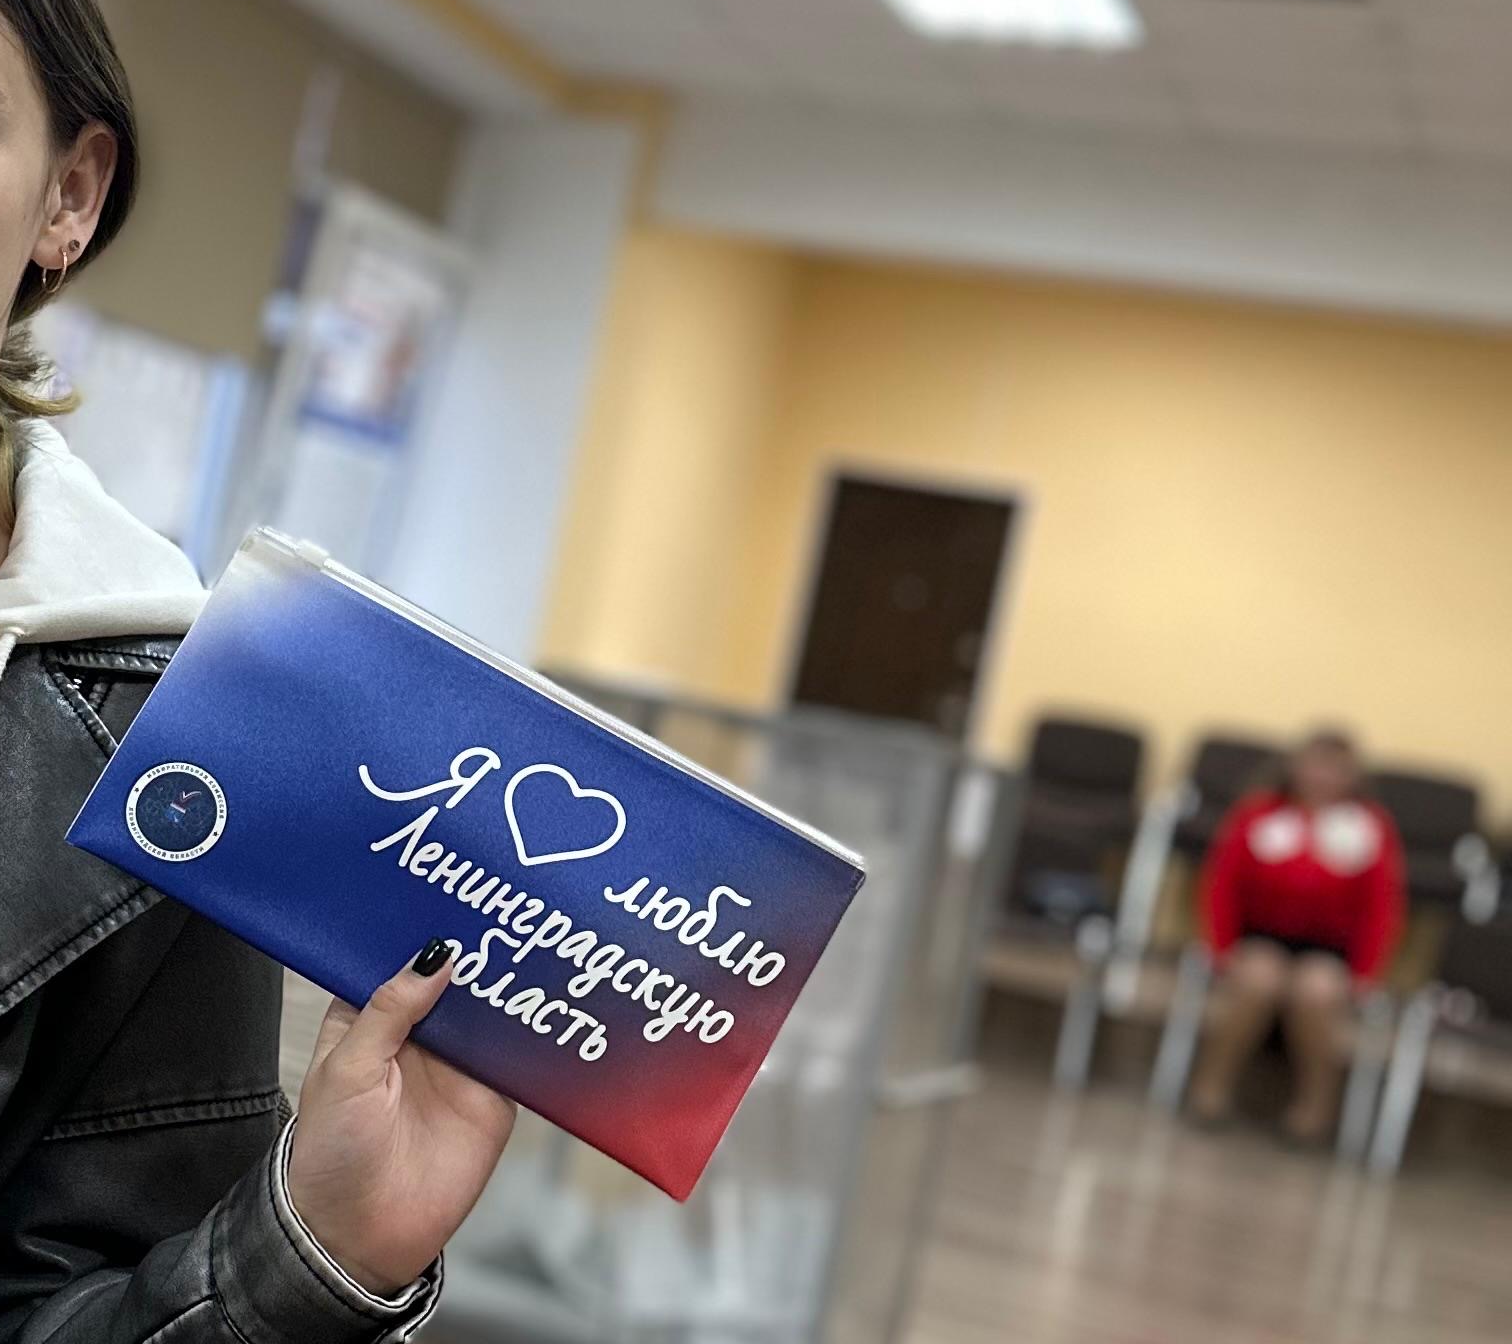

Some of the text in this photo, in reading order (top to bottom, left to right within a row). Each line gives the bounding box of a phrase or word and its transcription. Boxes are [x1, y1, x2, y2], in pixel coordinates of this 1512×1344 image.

[359, 746, 787, 987] Я люблю
[370, 806, 735, 1044] Ленинградскую
